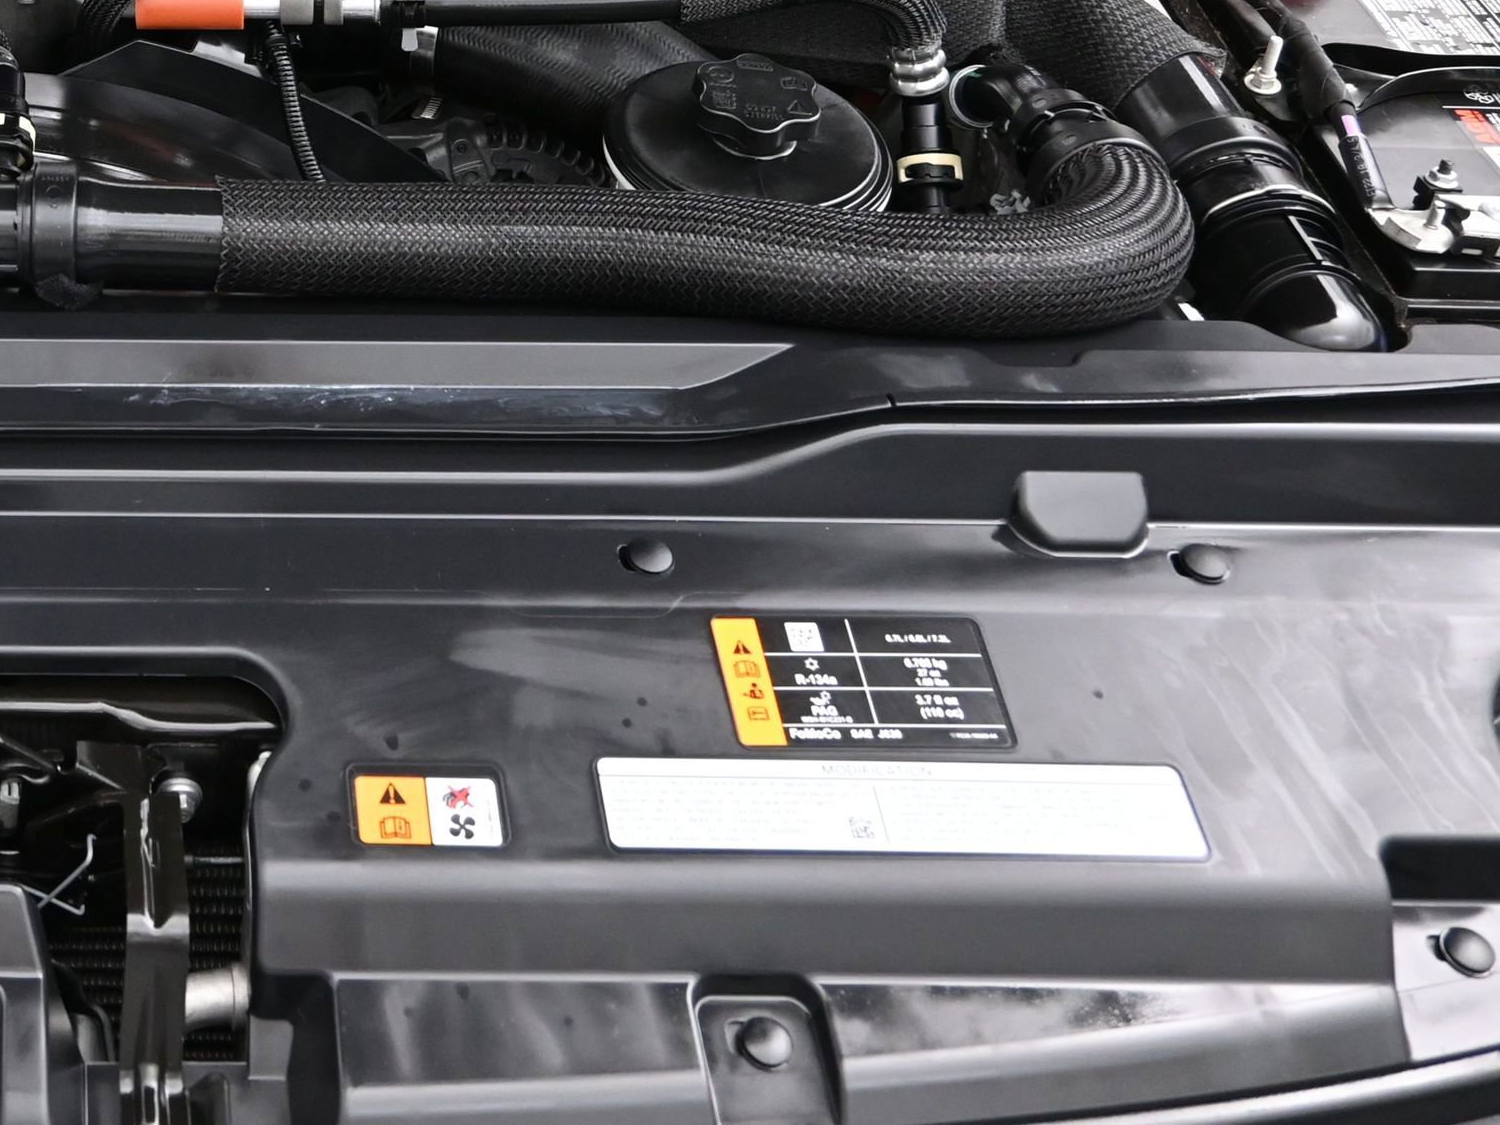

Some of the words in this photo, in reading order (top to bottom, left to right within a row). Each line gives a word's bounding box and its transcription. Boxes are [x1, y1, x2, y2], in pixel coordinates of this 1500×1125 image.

[794, 674, 838, 685] R-134a
[810, 705, 838, 716] PAG
[789, 728, 842, 739] FoMoCo
[821, 763, 933, 777] MODIFICATION
